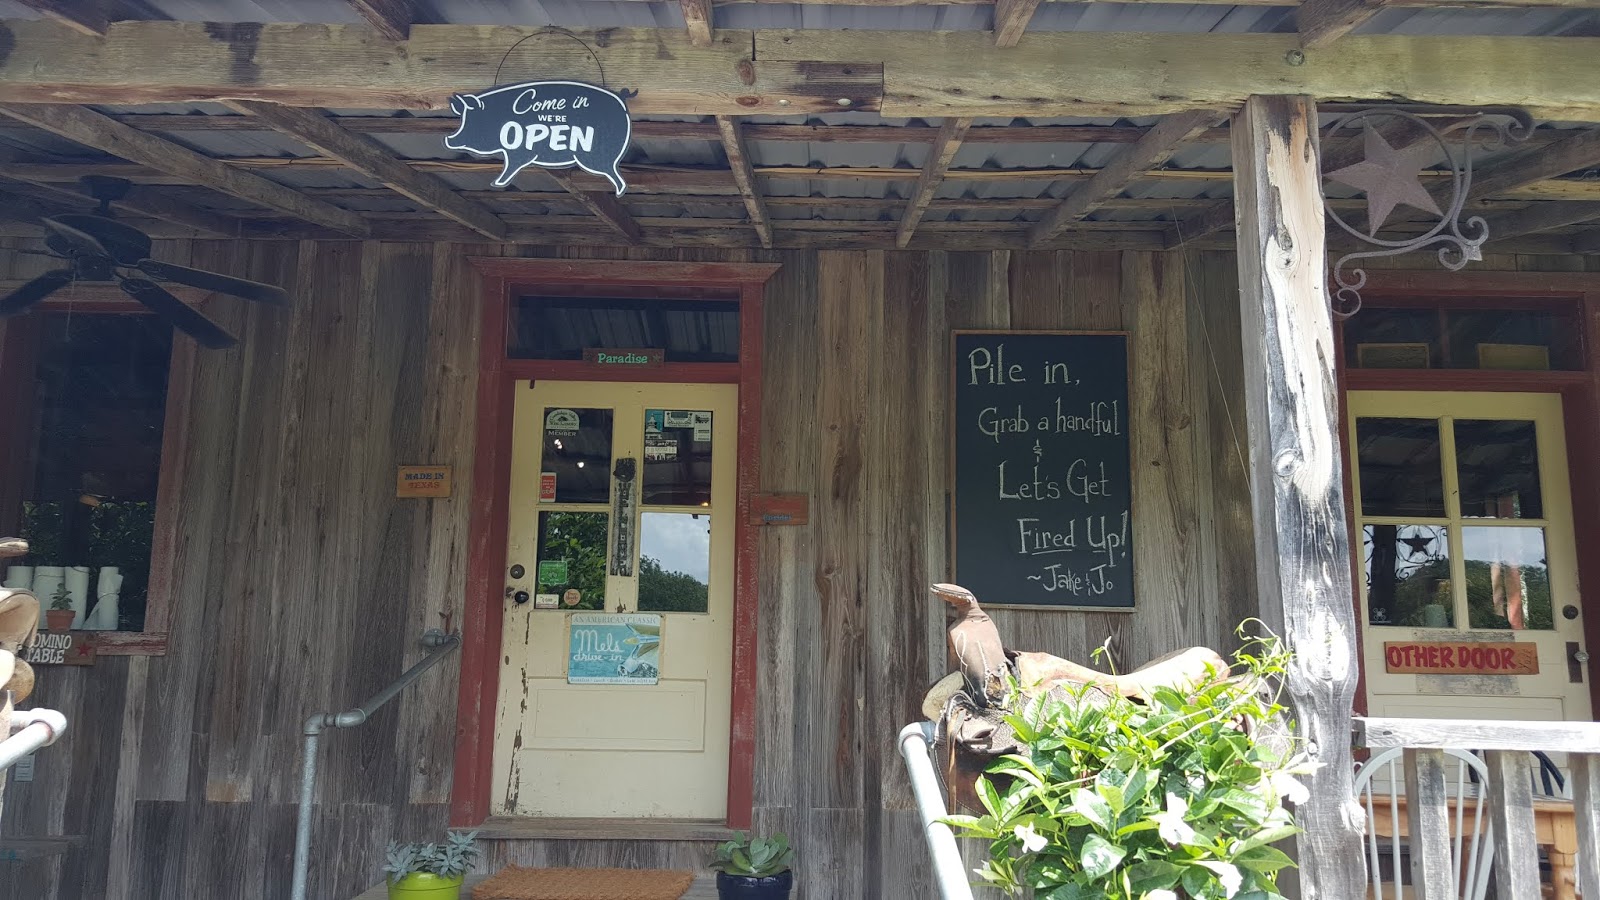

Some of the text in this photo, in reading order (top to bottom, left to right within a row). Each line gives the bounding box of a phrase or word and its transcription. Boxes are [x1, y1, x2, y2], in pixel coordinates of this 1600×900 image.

[513, 89, 590, 114] Come in
[538, 114, 567, 122] WE'RE
[500, 121, 594, 152] OPEN
[598, 352, 648, 364] Paradise
[968, 343, 1080, 385] Pile in,
[978, 397, 1120, 444] Grab a handful
[408, 481, 440, 489] TEXAS
[434, 472, 444, 480] IN
[998, 458, 1111, 503] Let's Get
[1017, 509, 1128, 567] Fired Up!
[1090, 564, 1113, 594] Jo
[573, 615, 657, 625] AN AMERICAN CLASSIC
[32, 633, 72, 650] OMINO
[575, 629, 625, 652] Mels
[26, 647, 65, 664] TABLE
[573, 648, 626, 662] drive-in
[1388, 645, 1516, 670] OTHER DOOR
